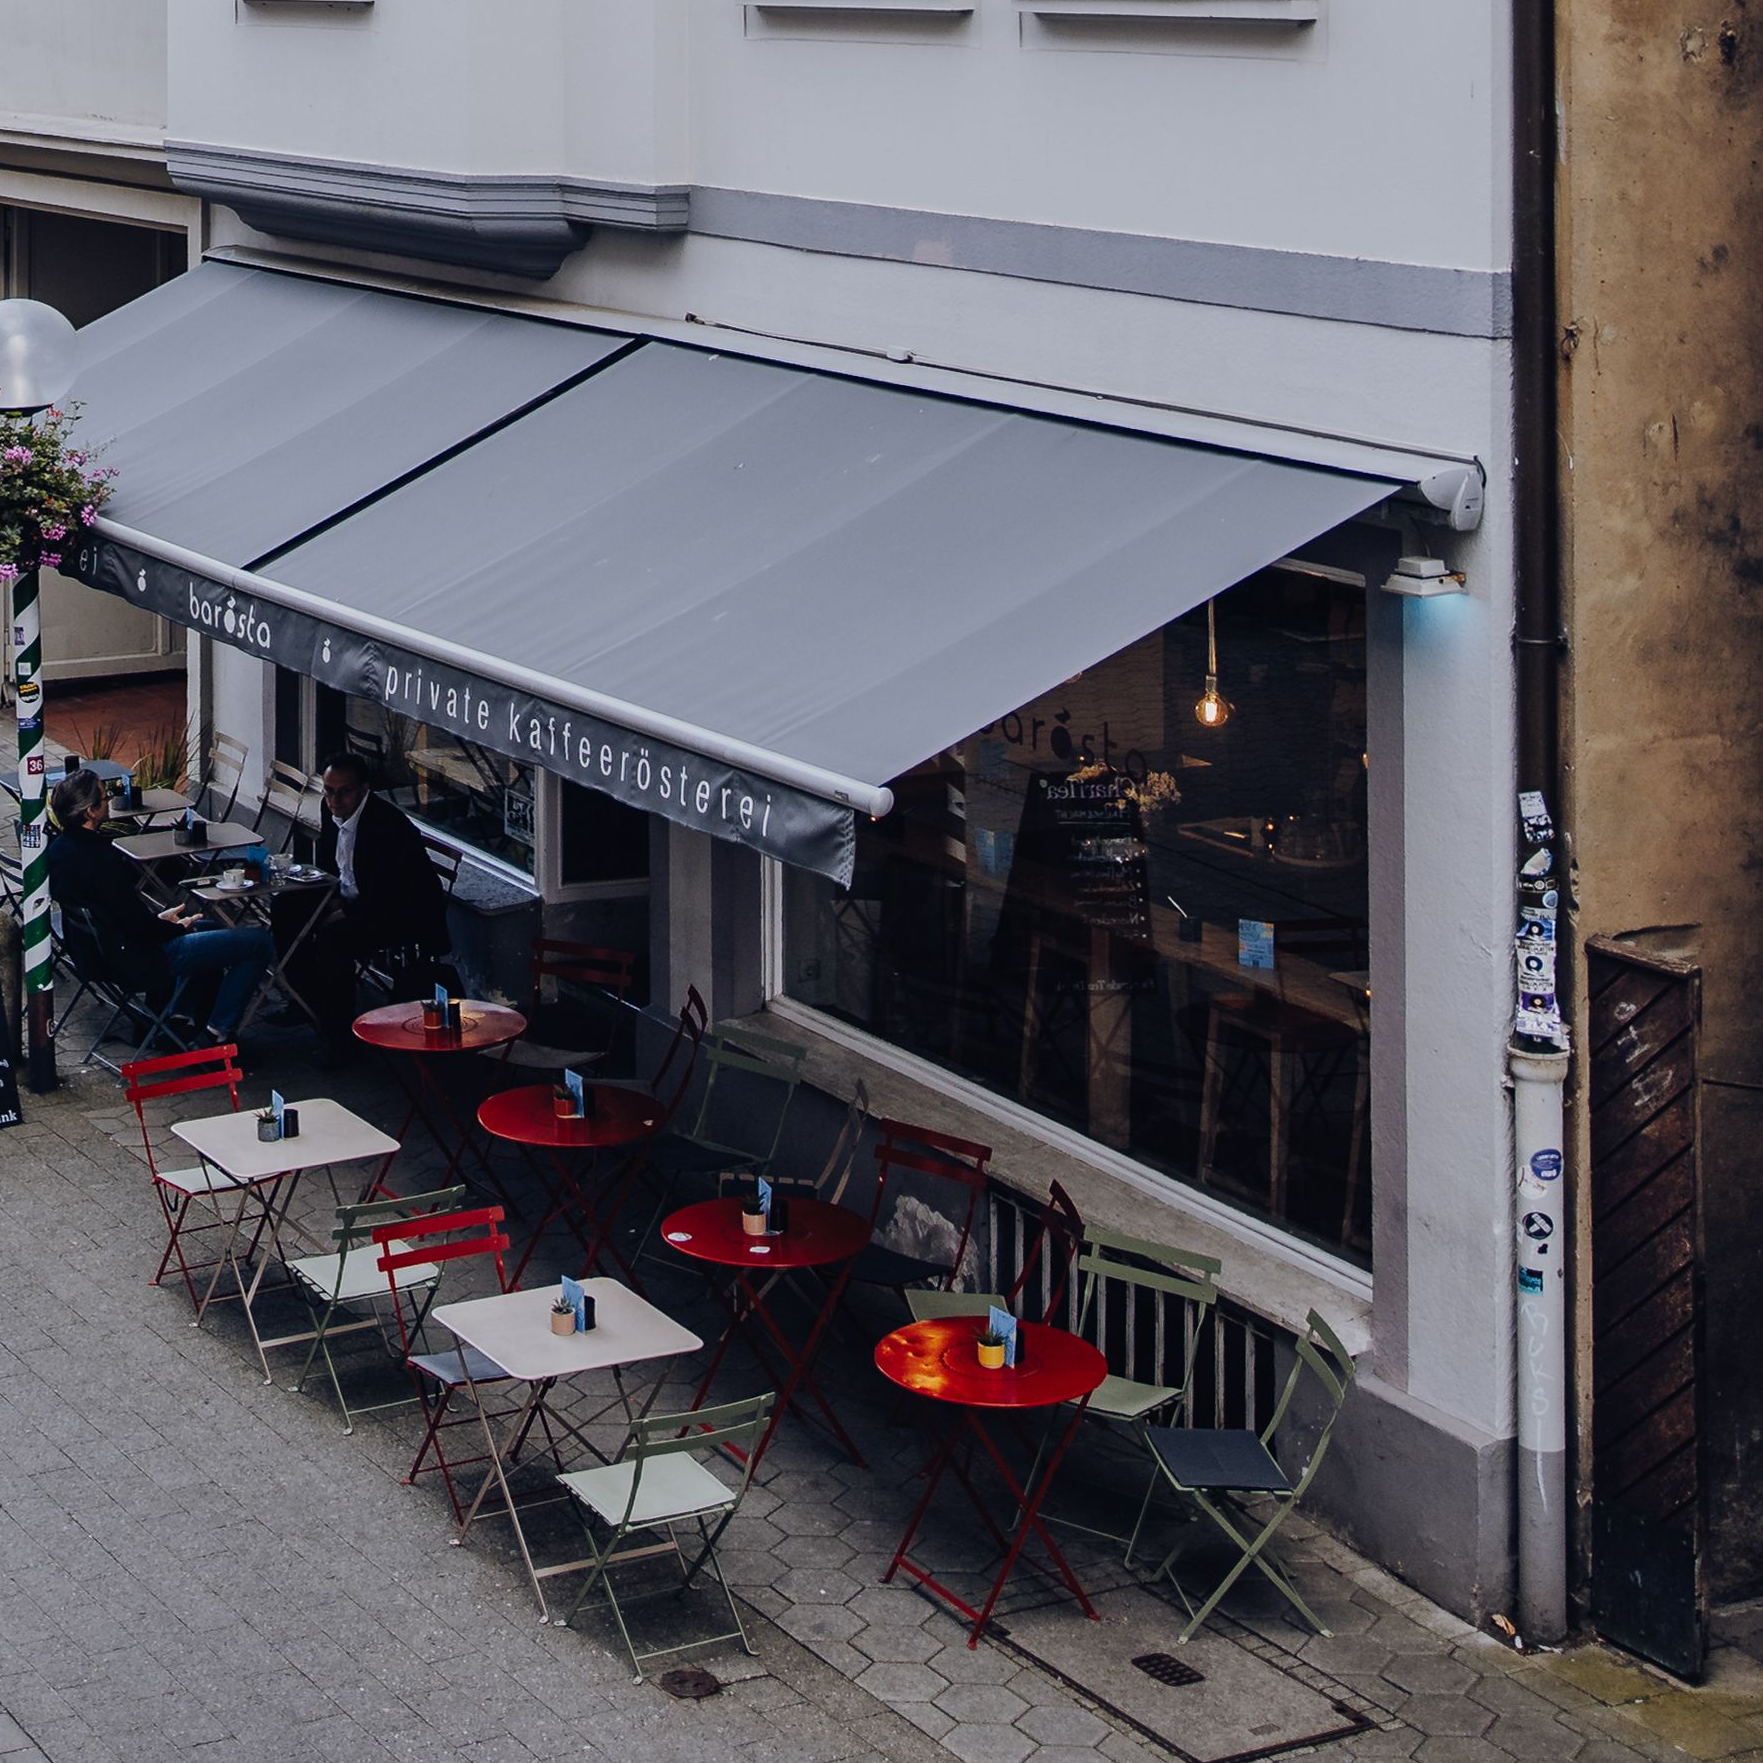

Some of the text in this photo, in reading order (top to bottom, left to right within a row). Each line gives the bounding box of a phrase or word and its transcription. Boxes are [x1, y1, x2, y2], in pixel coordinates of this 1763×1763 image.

[29, 759, 43, 772] 36
[384, 664, 773, 837] private kaffeerösterei
